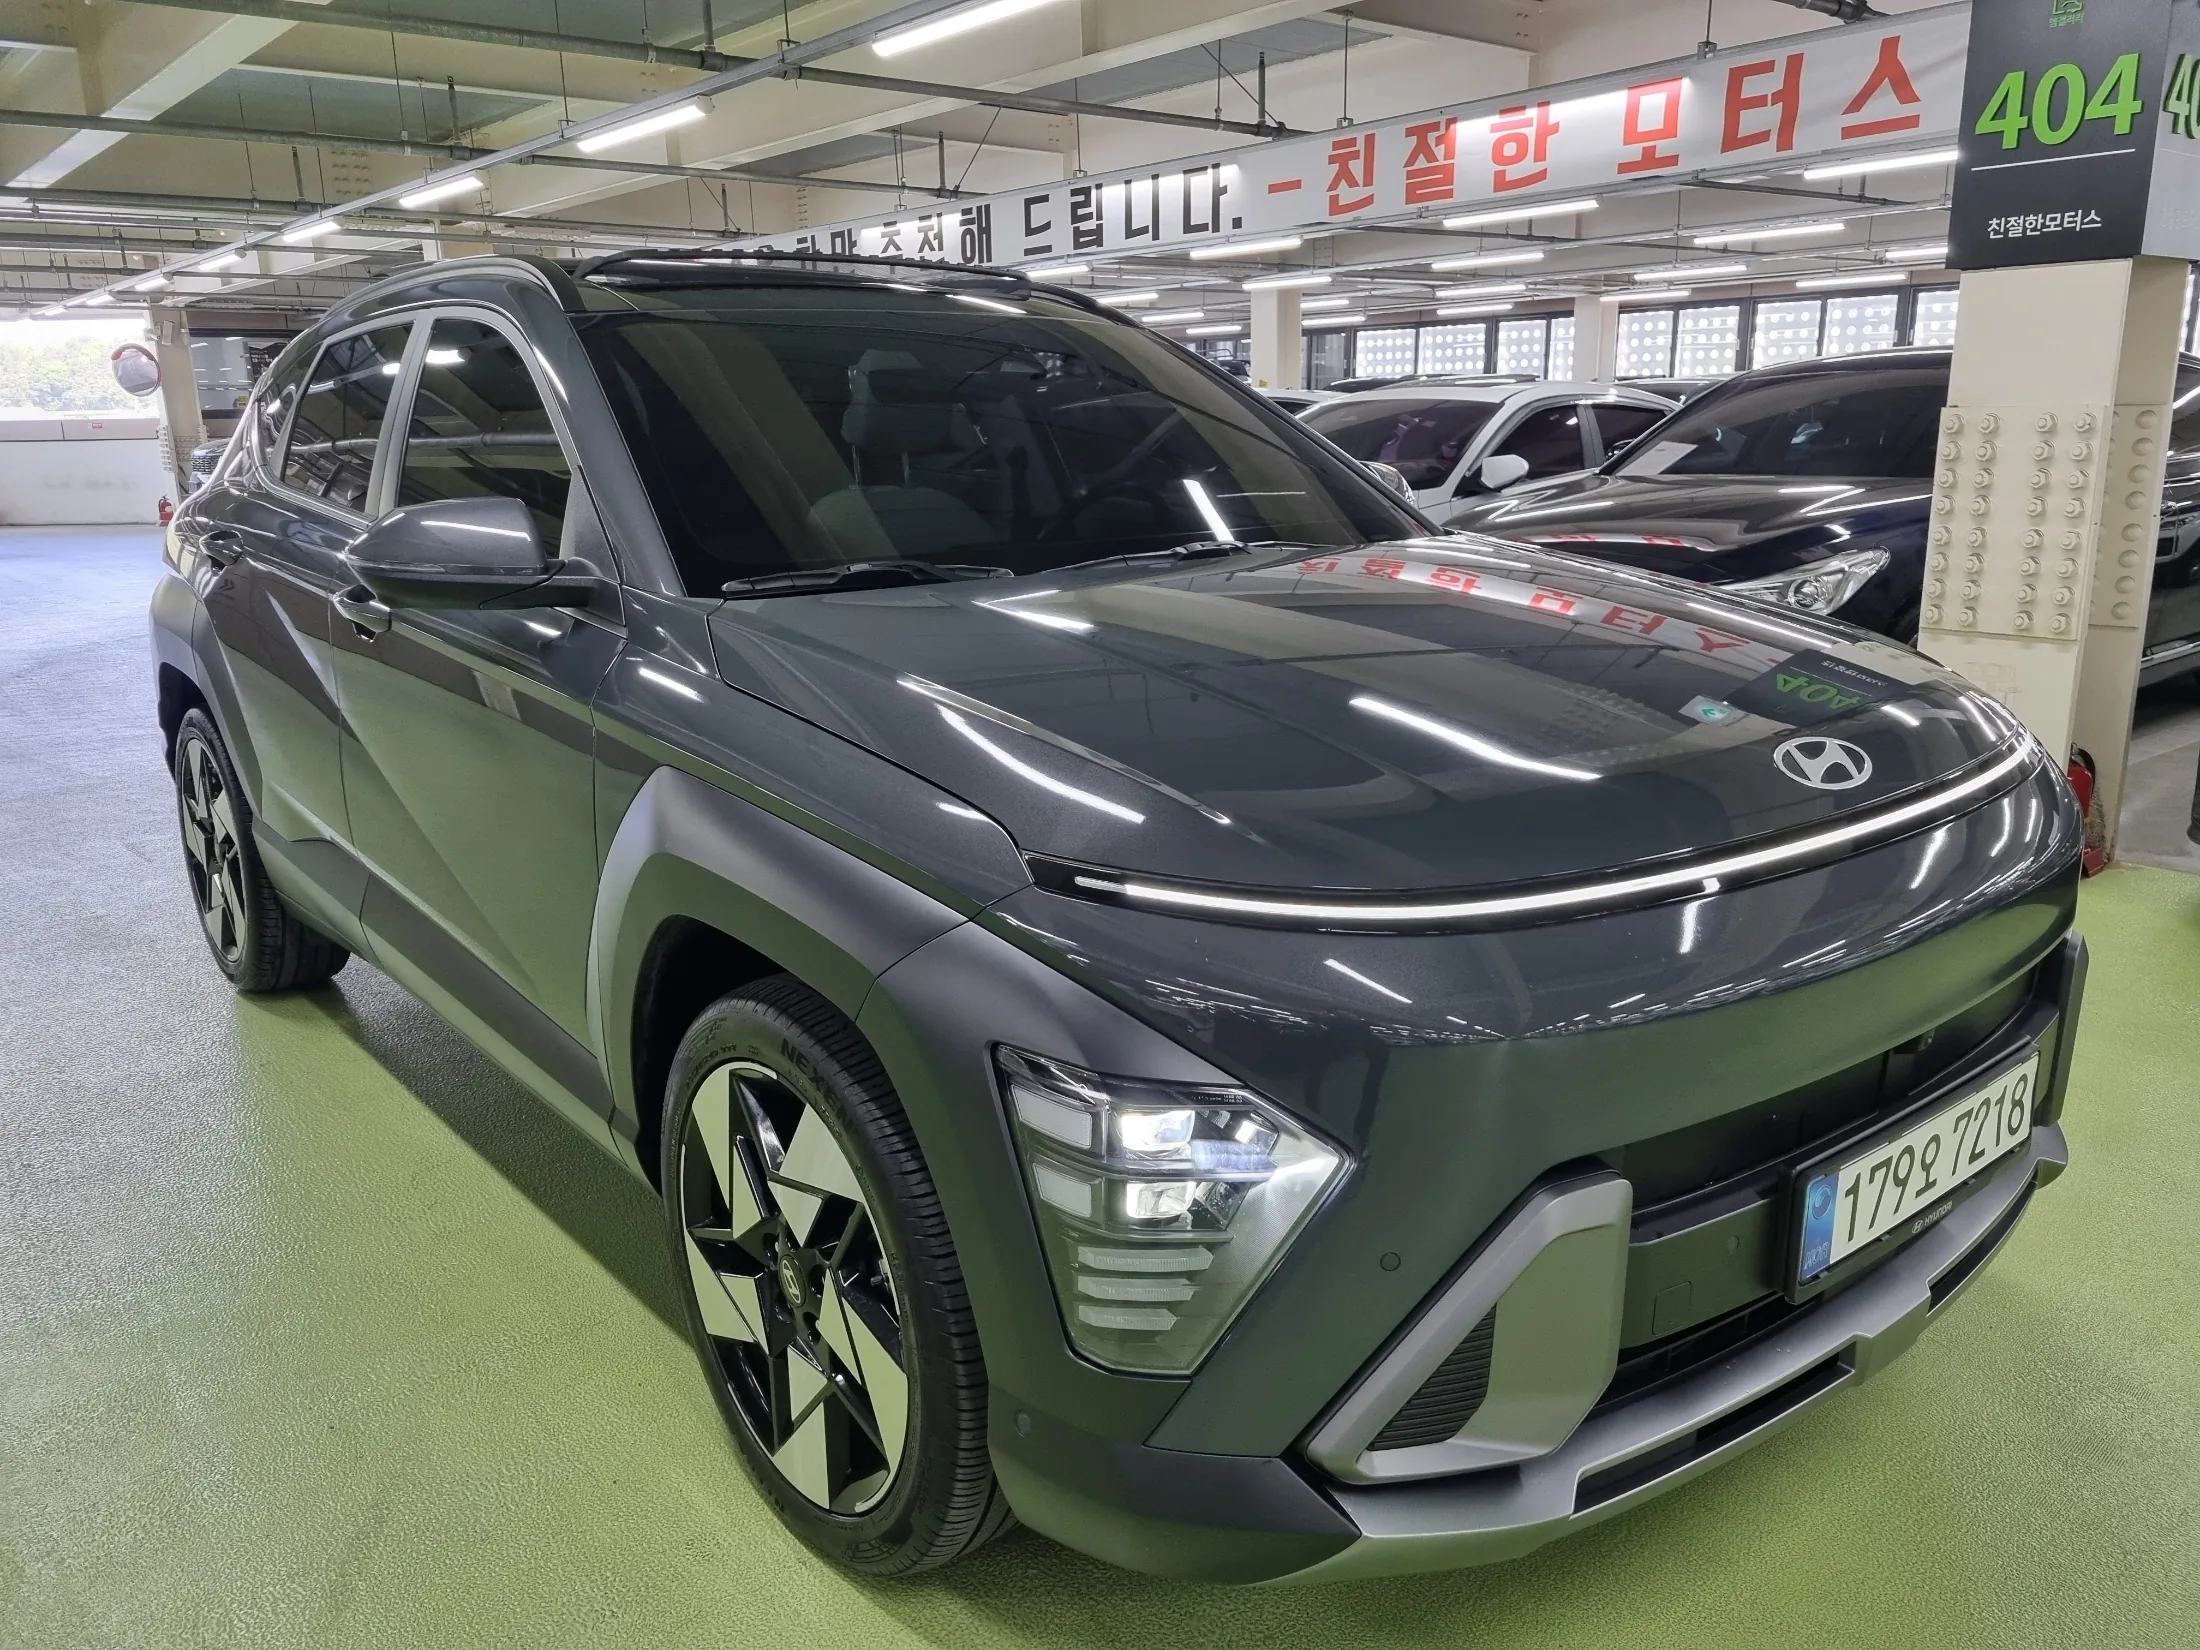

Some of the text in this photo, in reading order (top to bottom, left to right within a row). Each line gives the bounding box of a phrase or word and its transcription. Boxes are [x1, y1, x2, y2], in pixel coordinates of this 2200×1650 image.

[1974, 53, 2143, 150] 404
[2163, 53, 2200, 139] 40
[1023, 162, 1243, 256] 드립니다.
[1326, 101, 1561, 217] 친절한
[1617, 35, 1921, 175] 모터스
[1987, 209, 2102, 239] 친절한모터스
[1844, 1073, 2029, 1243] 179오 7218
